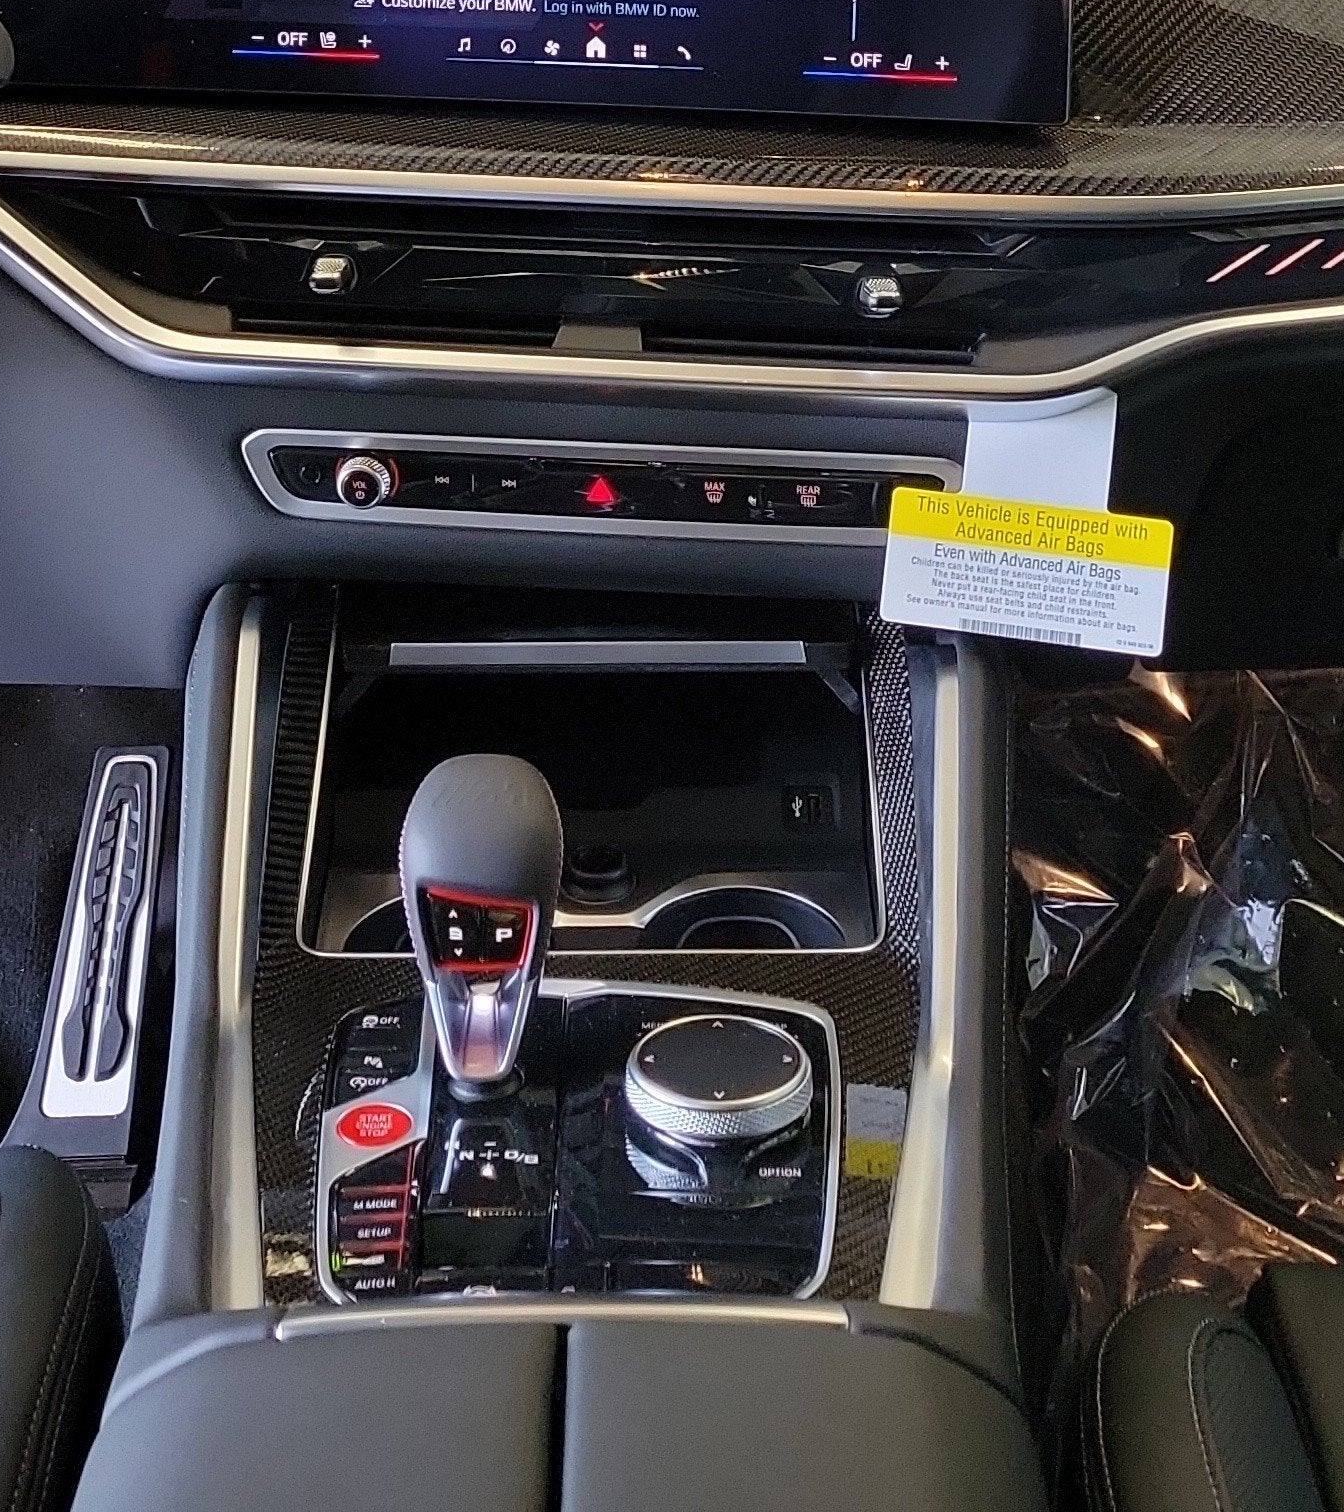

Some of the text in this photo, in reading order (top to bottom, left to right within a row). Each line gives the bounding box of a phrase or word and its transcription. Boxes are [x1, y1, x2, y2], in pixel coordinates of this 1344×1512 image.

[544, 0, 568, 15] Log
[571, 1, 583, 13] in
[586, 2, 612, 15] with
[615, 3, 649, 16] BMW
[653, 4, 666, 17] ID
[670, 6, 699, 18] now.
[277, 31, 309, 47] OFF
[851, 52, 883, 68] OFF
[704, 481, 725, 492] MAX
[796, 484, 821, 496] REAR
[917, 495, 1148, 540] This Vehicle is Equipped with
[955, 521, 1104, 558] Advanced Air Bags
[934, 543, 1121, 582] Even with Advanced Air Bags
[911, 556, 945, 568] Children
[947, 562, 962, 570] can
[964, 562, 974, 572] be
[977, 565, 998, 576] killed
[1012, 570, 1049, 584] seriously
[1051, 575, 1080, 587] injured
[1083, 578, 1093, 589] by
[1095, 580, 1108, 590] the
[1110, 582, 1121, 591] air
[934, 569, 948, 578] The
[951, 570, 969, 581] back
[972, 574, 989, 584] seat
[991, 575, 998, 585] is
[1001, 576, 1014, 587] the
[1016, 579, 1041, 591] safest
[1043, 583, 1064, 596] place
[1067, 586, 1079, 595] for
[931, 578, 954, 589] Never
[958, 582, 971, 592] put
[980, 585, 1025, 599] rear-facing
[1027, 589, 1047, 601] child
[1049, 594, 1067, 603] seat
[1069, 596, 1077, 604] in
[1079, 597, 1092, 606] the
[938, 589, 966, 601] Always
[969, 593, 983, 602] use
[985, 595, 1002, 605] seat
[1004, 597, 1024, 608] belts
[1027, 599, 1042, 609] and
[1044, 601, 1064, 612] child
[906, 594, 921, 604] See
[957, 601, 988, 612] manual
[990, 605, 1002, 614] for
[1004, 608, 1025, 618] more
[1027, 609, 1075, 624] information
[1078, 615, 1102, 628] about
[1103, 620, 1114, 629] air
[496, 928, 513, 943] P
[380, 1016, 400, 1025] OFF
[367, 1077, 389, 1086] OFF
[359, 1113, 394, 1123] START
[357, 1121, 393, 1130] ENGINE
[360, 1128, 389, 1138] STOP
[459, 1149, 475, 1161] N
[759, 1167, 802, 1179] OPTION
[366, 1198, 397, 1209] MODE
[357, 1227, 392, 1239] SETUP
[354, 1278, 385, 1290] AUTO
